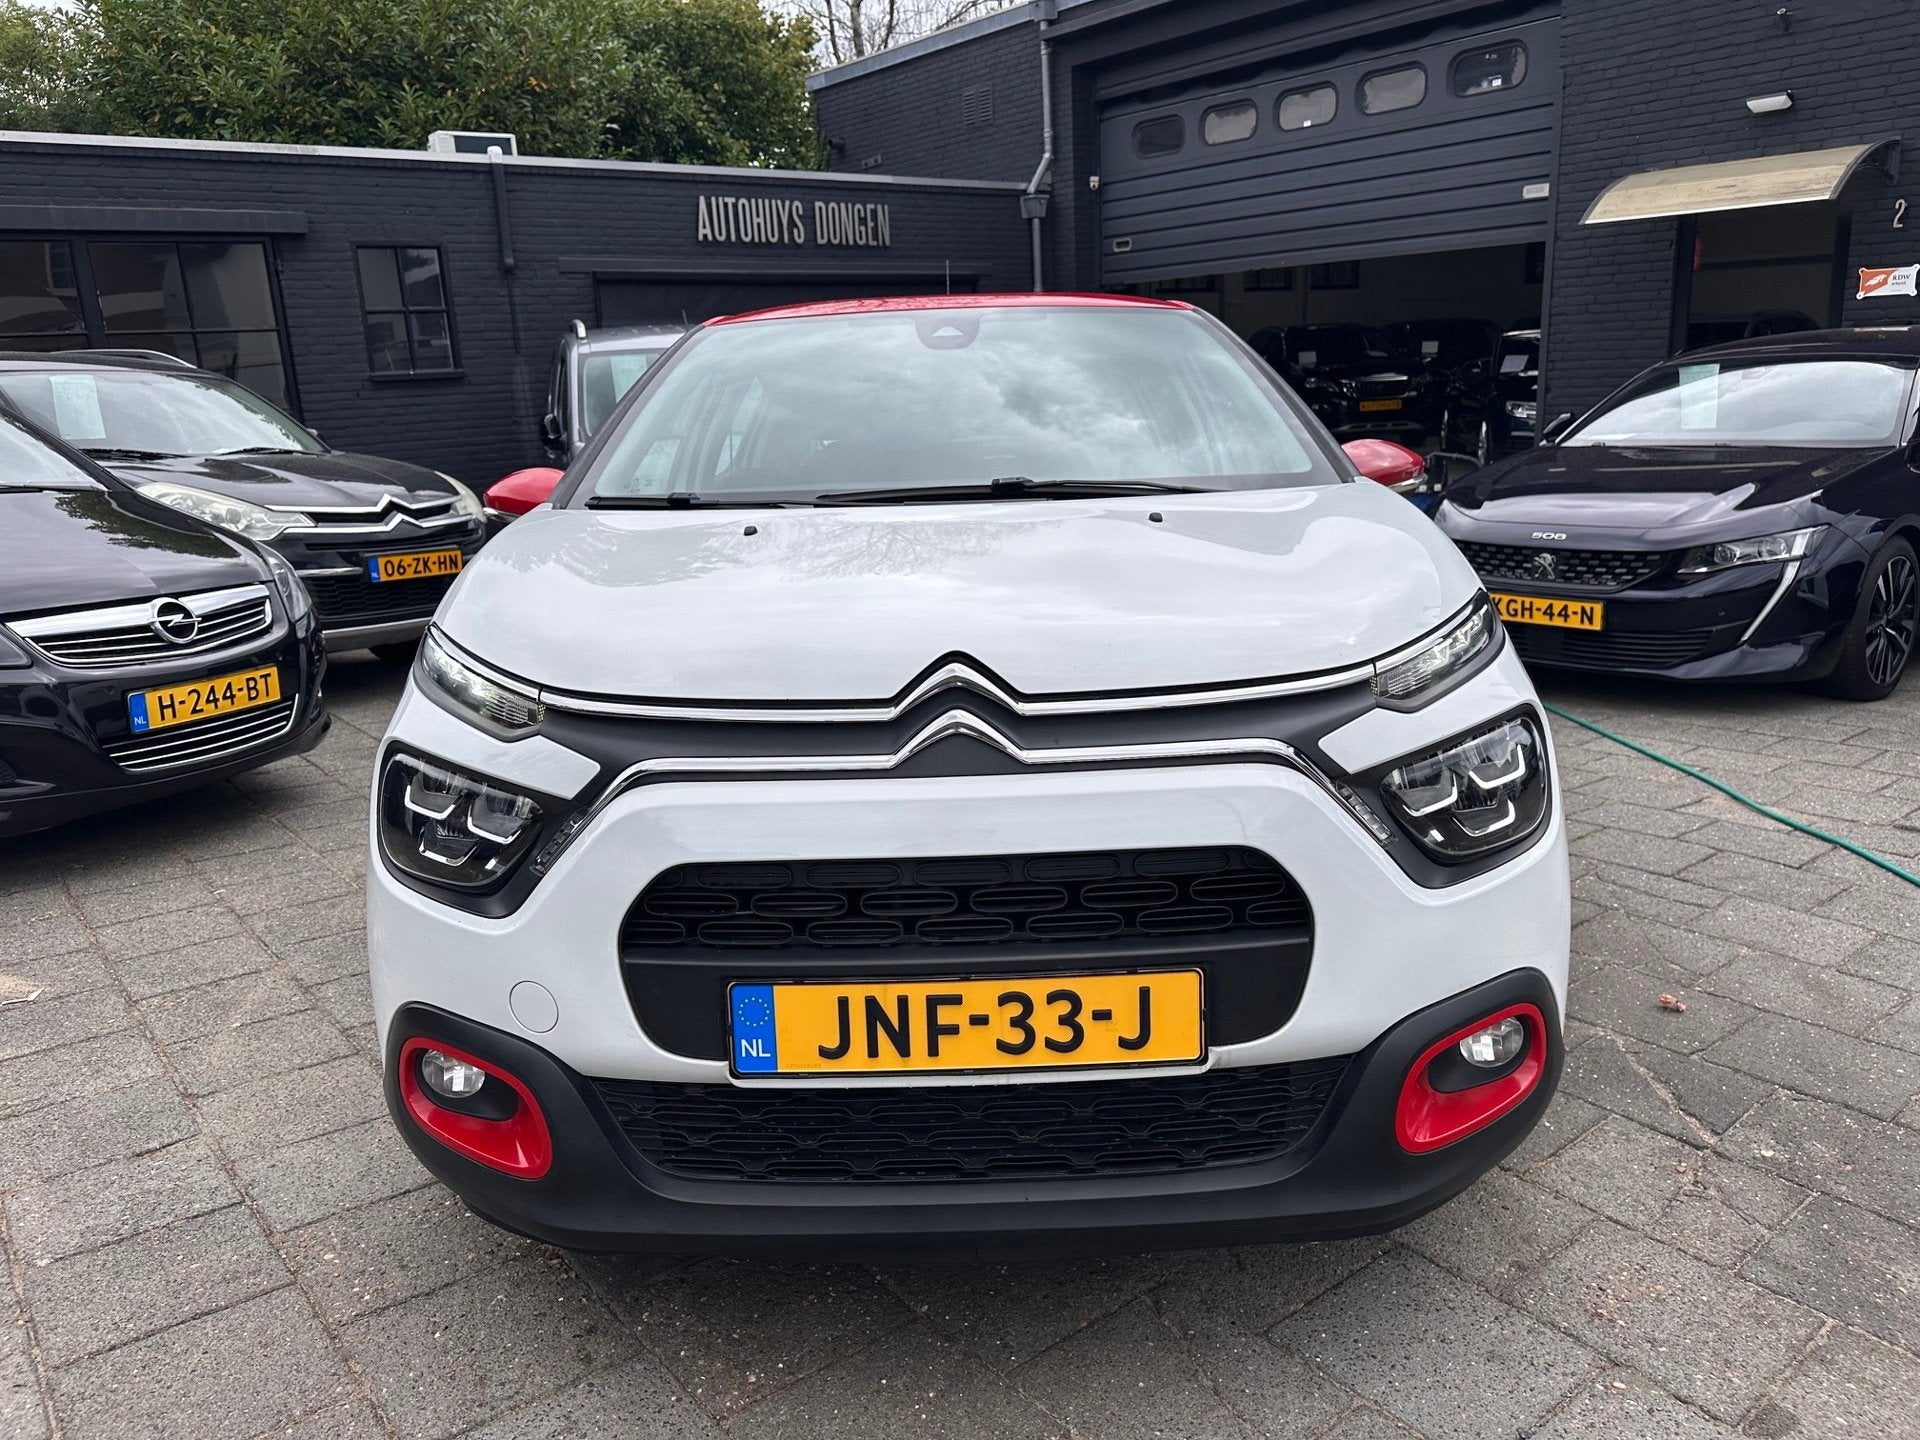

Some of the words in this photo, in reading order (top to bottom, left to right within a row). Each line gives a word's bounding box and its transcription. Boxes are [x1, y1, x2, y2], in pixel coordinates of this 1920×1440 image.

[698, 195, 805, 244] AUTOHUYS
[814, 201, 891, 247] DONGEN
[1892, 198, 1906, 229] 2
[1892, 273, 1911, 282] RDW
[1531, 531, 1567, 541] 508
[383, 553, 459, 577] 06-ZK-HN
[157, 672, 272, 722] H-244-BT
[133, 716, 147, 726] NL
[817, 985, 1152, 1060] JNF-33-J
[740, 1038, 772, 1058] NL
